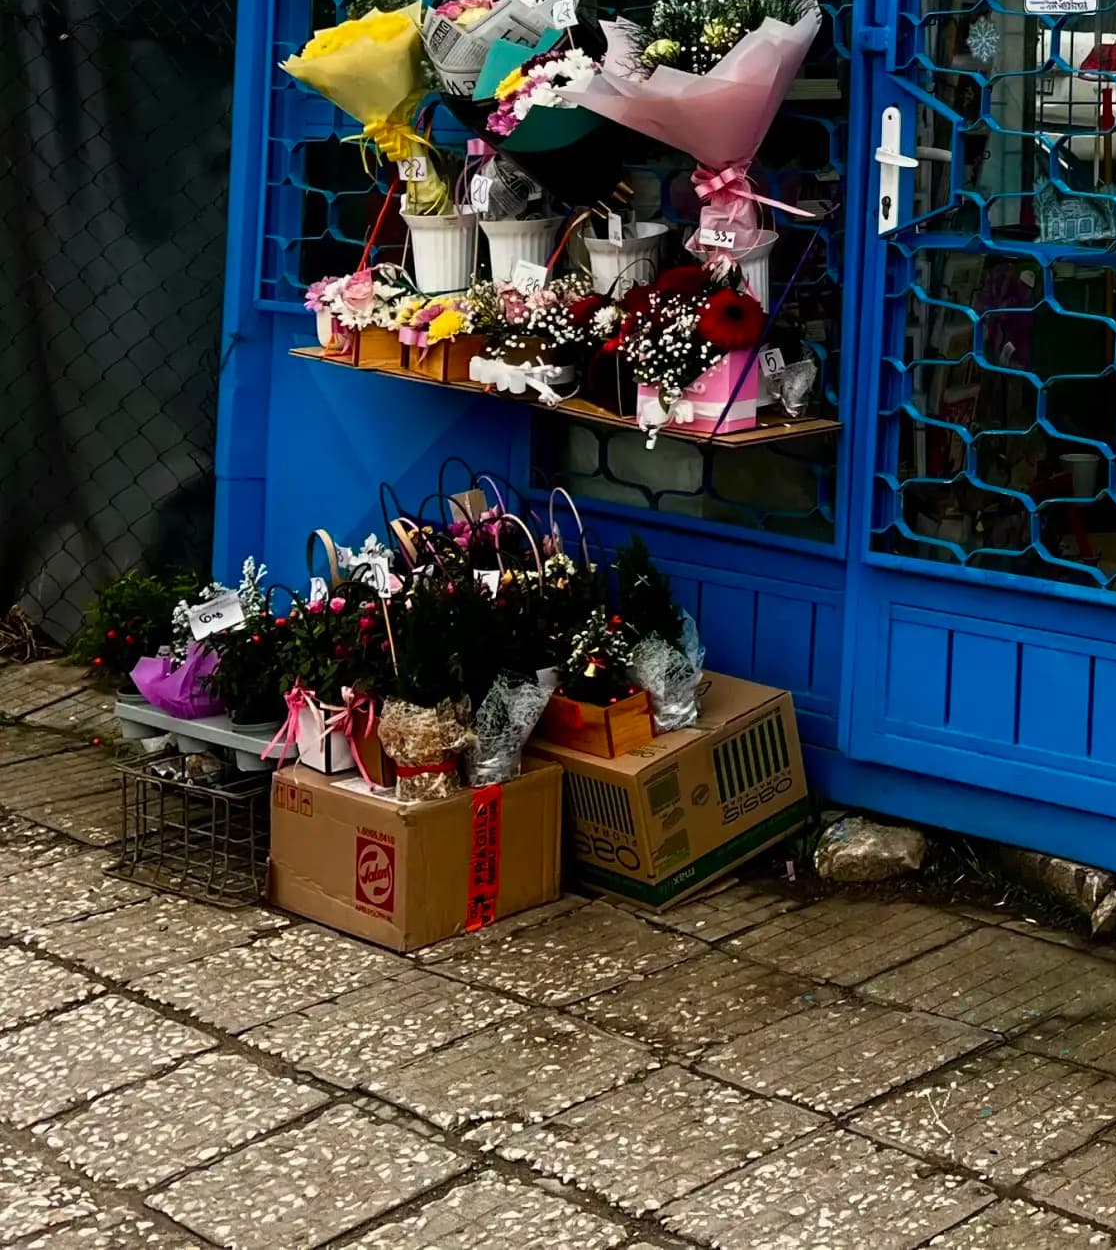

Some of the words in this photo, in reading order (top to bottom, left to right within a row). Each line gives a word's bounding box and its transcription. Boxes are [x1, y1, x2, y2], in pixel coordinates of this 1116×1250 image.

[473, 177, 488, 205] 20
[764, 352, 778, 372] 5
[722, 777, 793, 826] oasis
